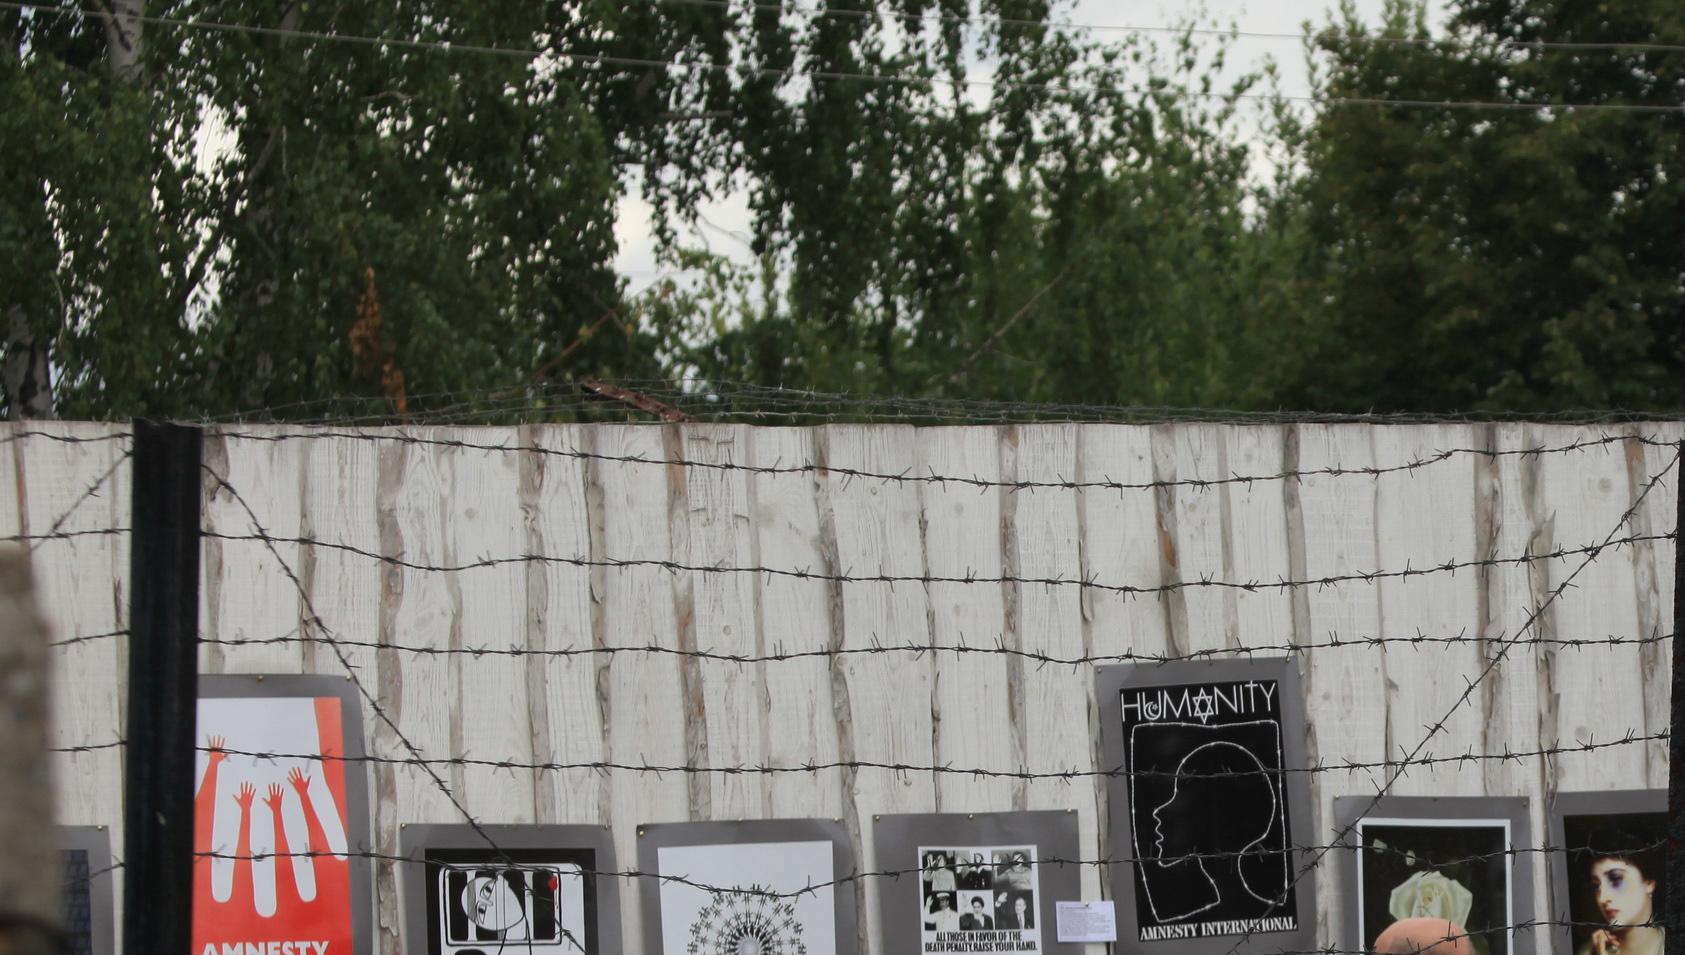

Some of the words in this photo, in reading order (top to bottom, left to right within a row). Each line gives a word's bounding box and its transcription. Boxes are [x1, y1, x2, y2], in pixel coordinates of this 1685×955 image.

[1140, 923, 1198, 941] AMNESTY
[1201, 916, 1298, 937] INTERNATIONAL
[946, 931, 967, 941] THOSE
[976, 931, 997, 941] FAVOR
[998, 931, 1007, 940] OF
[1008, 931, 1022, 940] THE
[925, 942, 945, 952] DEATH
[995, 941, 1014, 951] YOUR
